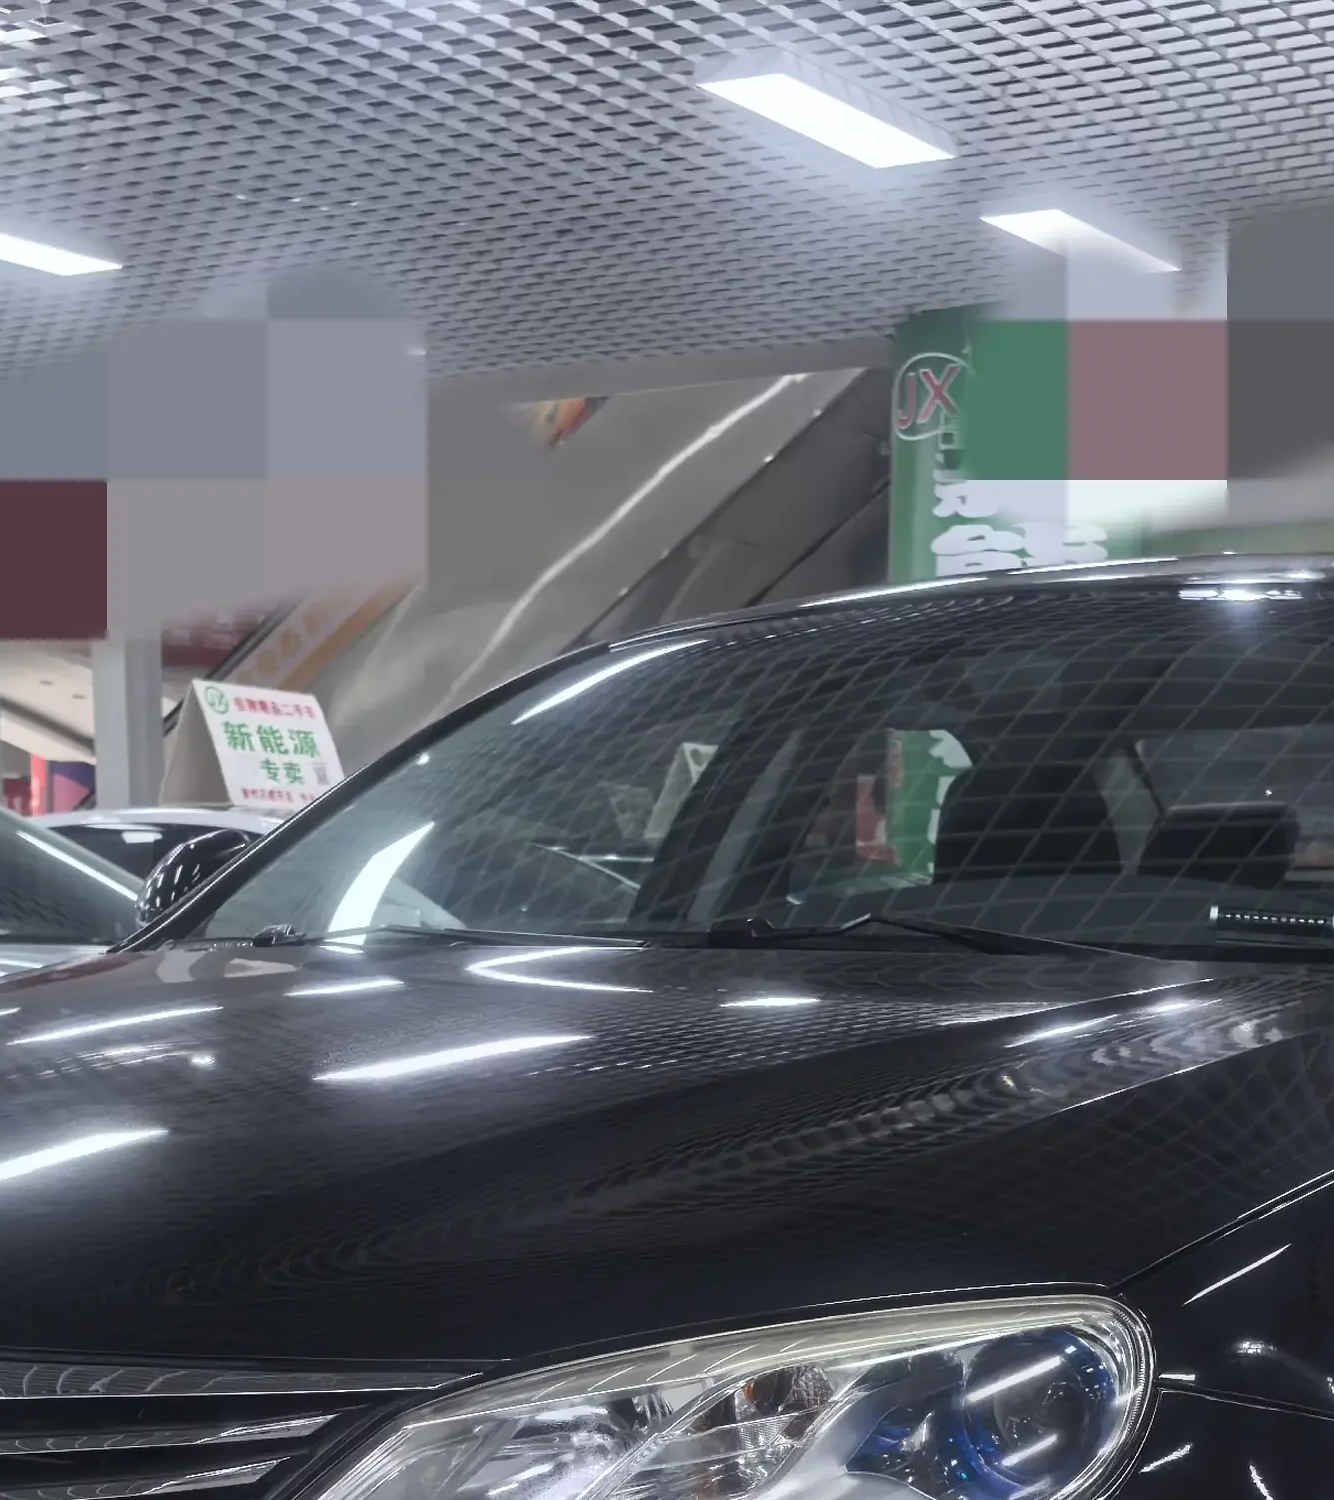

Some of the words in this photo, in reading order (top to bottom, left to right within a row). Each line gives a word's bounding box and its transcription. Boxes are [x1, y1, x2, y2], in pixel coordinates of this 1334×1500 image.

[221, 720, 321, 758] 新能源
[259, 757, 305, 785] 专卖
